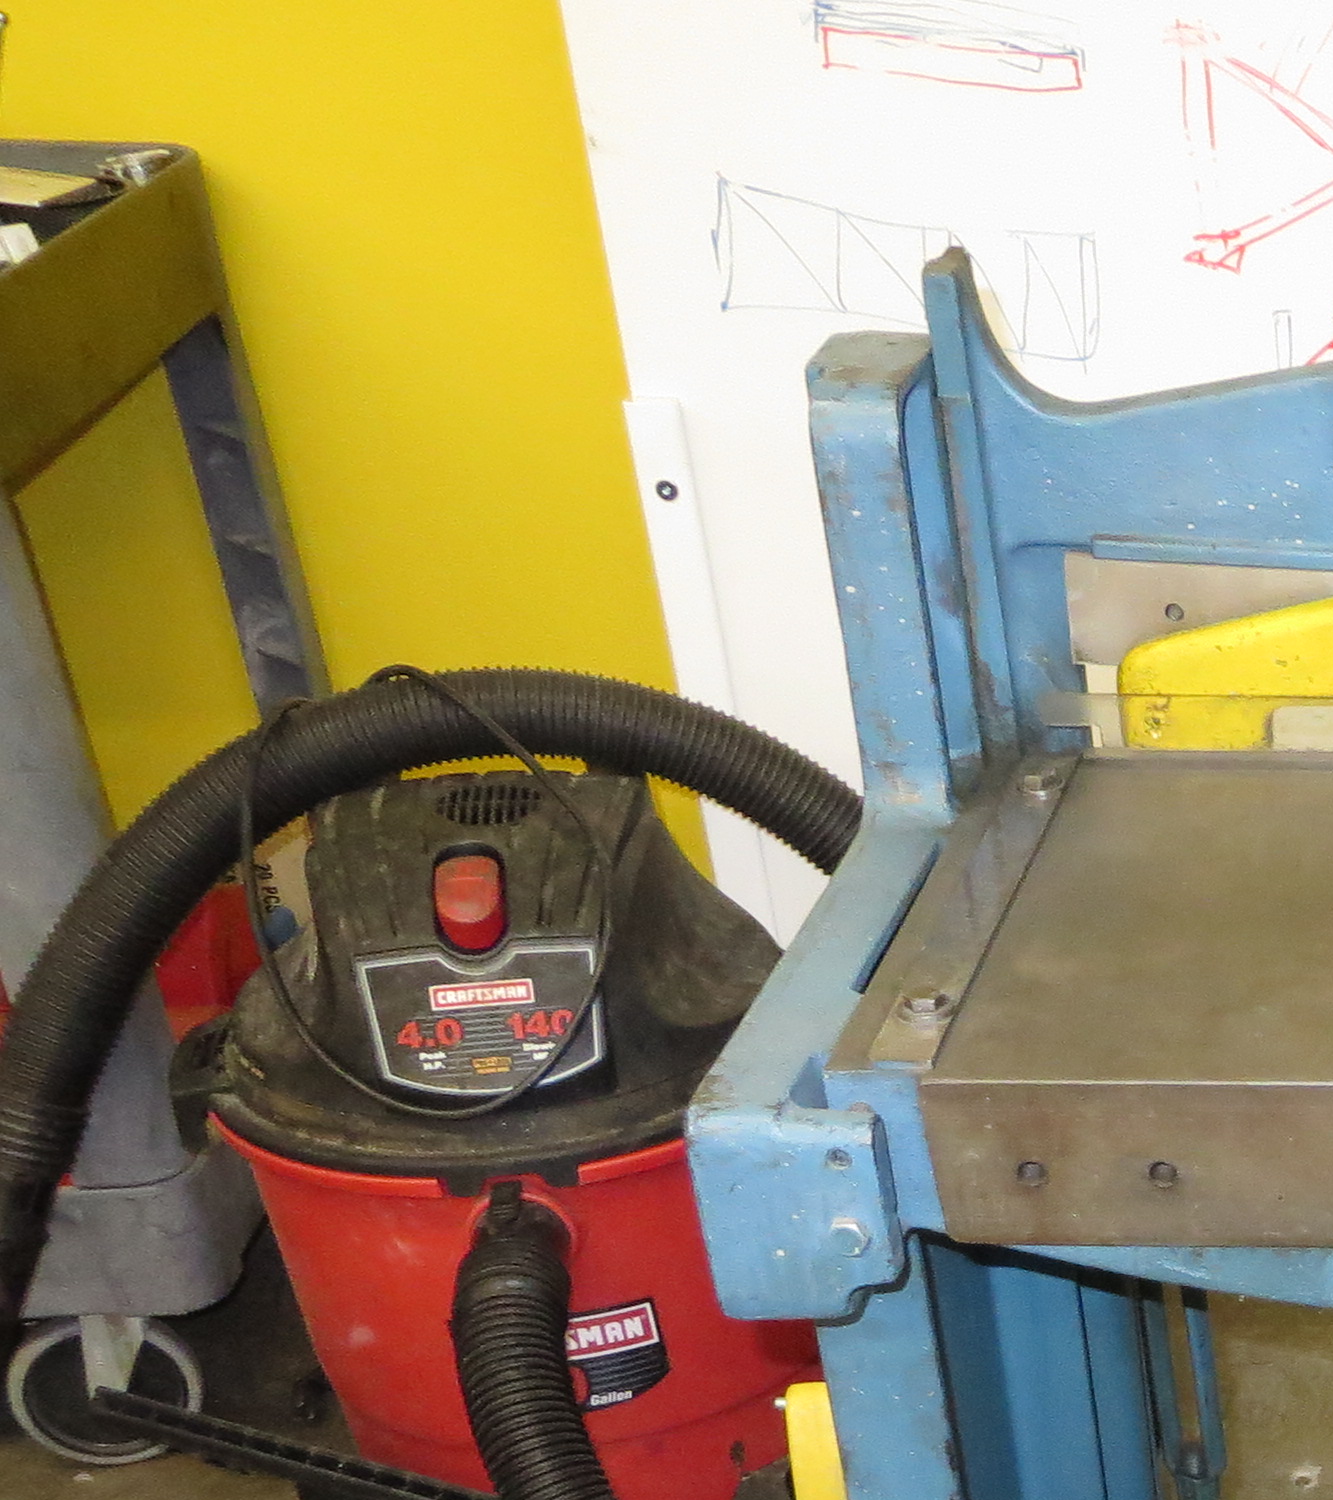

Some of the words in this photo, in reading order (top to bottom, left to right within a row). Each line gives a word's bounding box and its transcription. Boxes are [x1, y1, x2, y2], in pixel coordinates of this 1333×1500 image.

[435, 984, 529, 1005] CRAFTSMAN
[396, 1017, 465, 1048] 4.0
[507, 1008, 575, 1040] 140
[590, 1390, 633, 1406] Gallon
